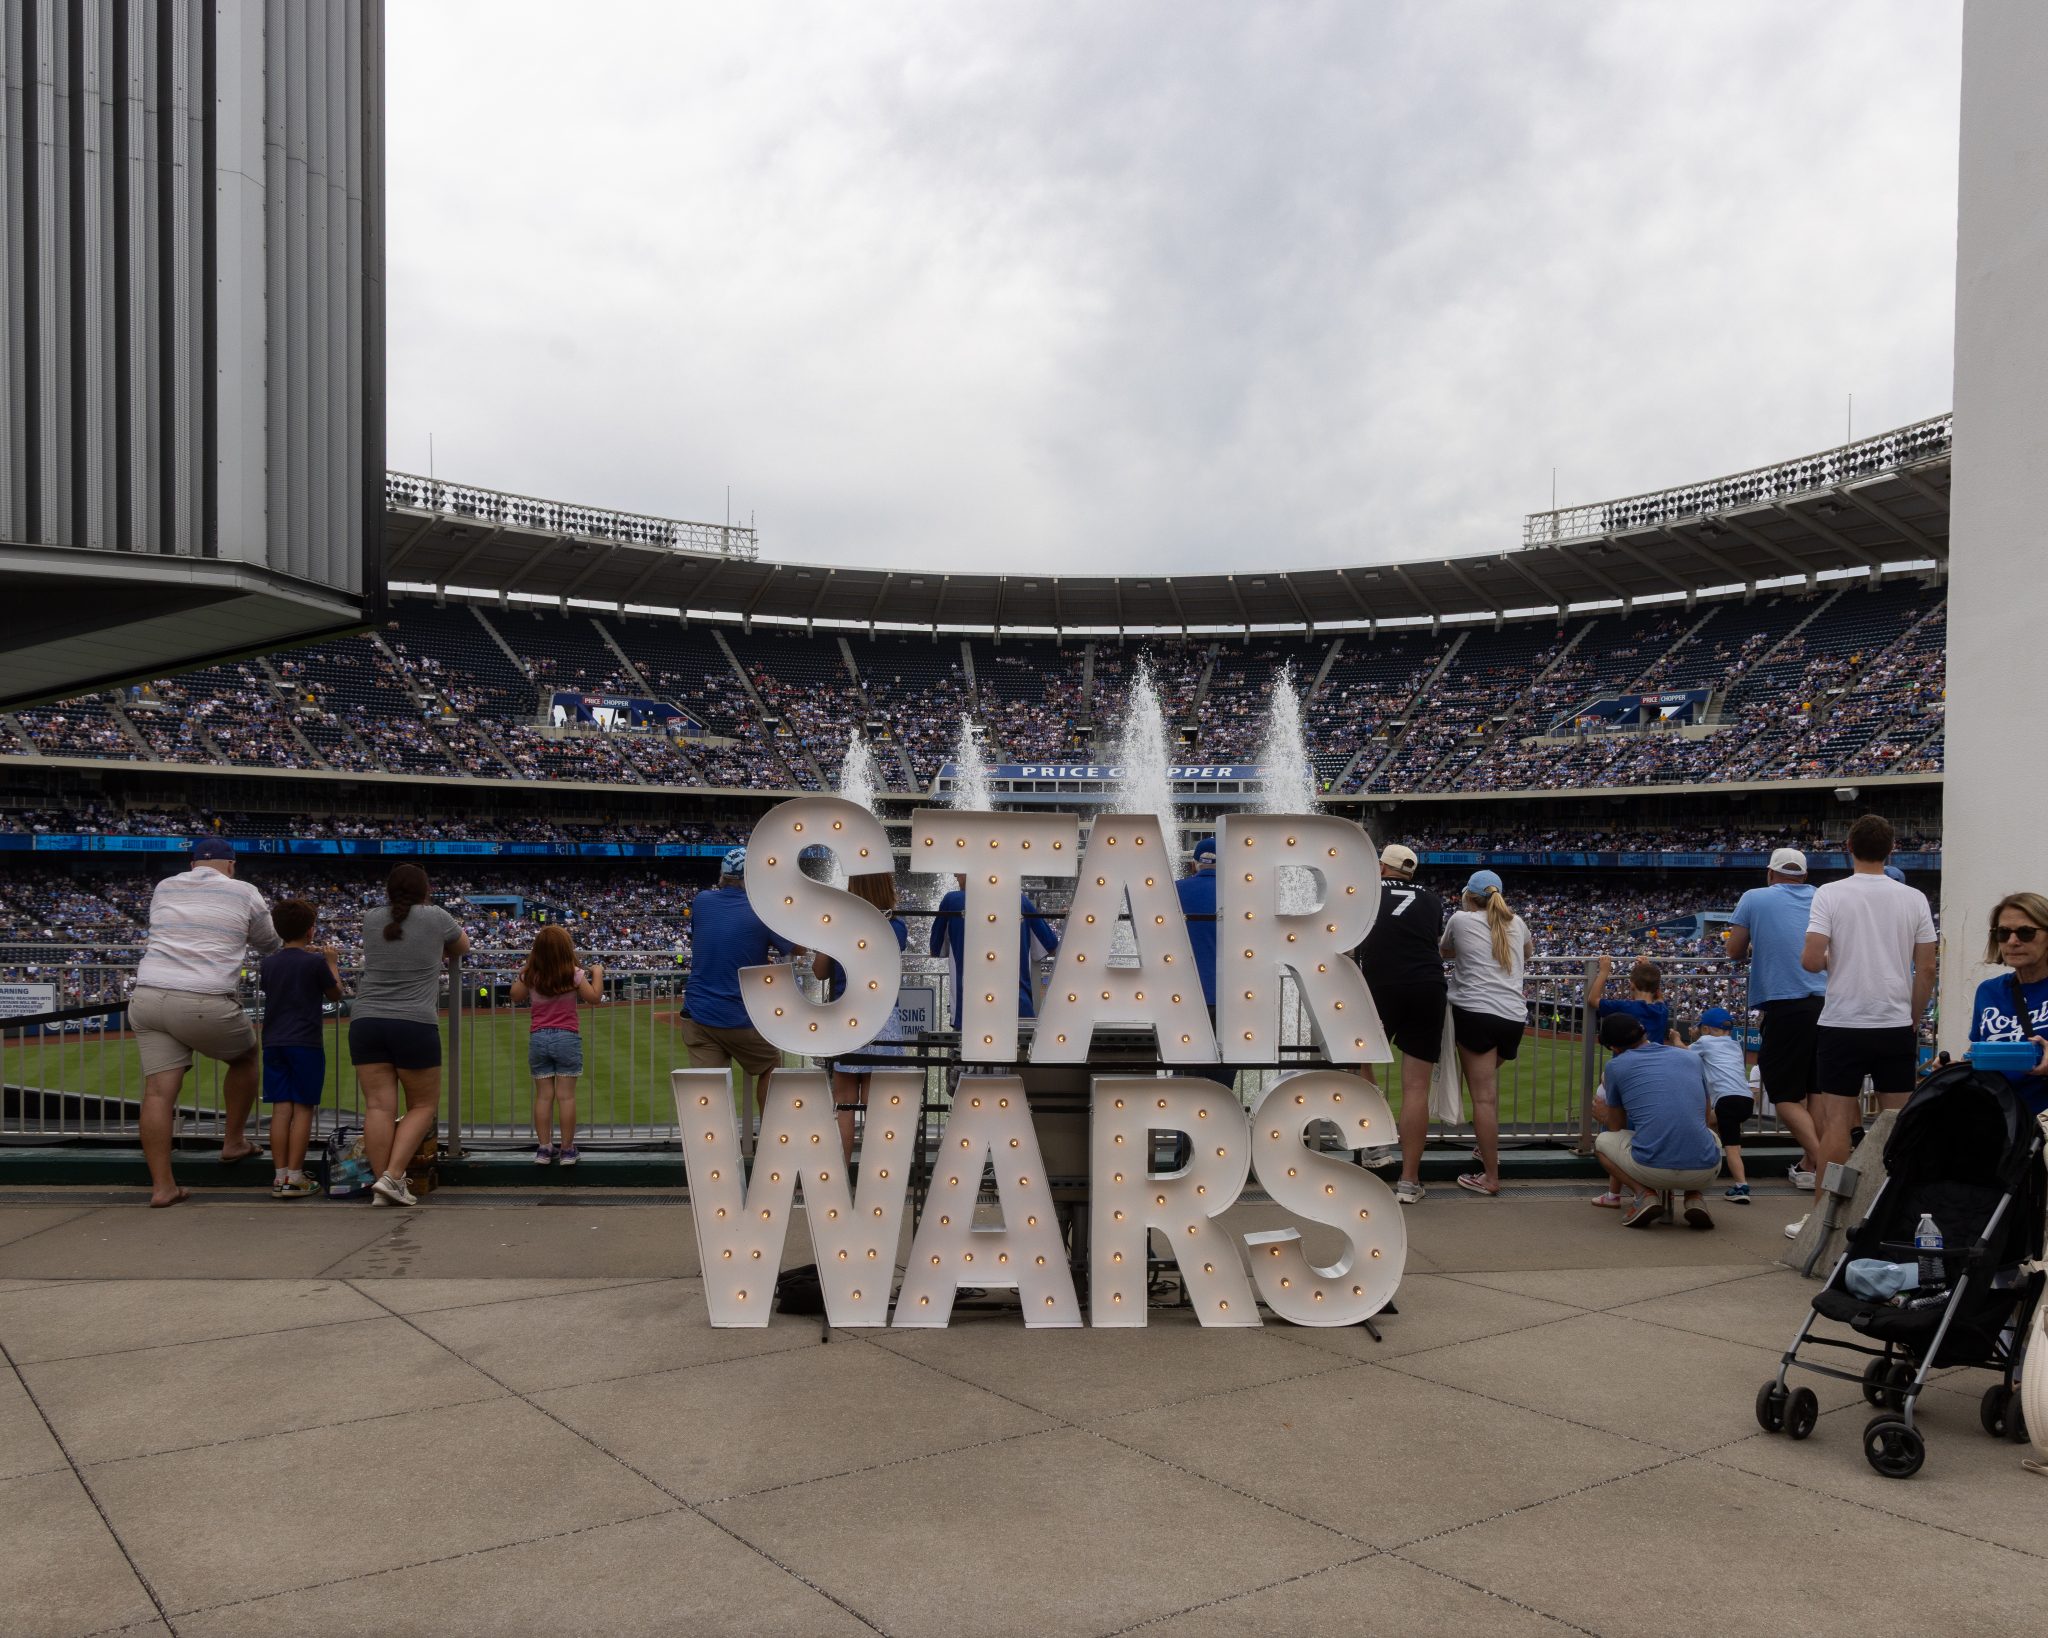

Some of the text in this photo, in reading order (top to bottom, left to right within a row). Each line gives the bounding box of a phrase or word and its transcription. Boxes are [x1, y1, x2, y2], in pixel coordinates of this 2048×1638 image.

[584, 697, 629, 707] PRICE CHOPPER
[1642, 694, 1686, 704] PRICE CHOPPER
[1022, 767, 1232, 777] PRICE CPPER
[1391, 889, 1416, 916] 7
[737, 797, 1393, 1065] STAR
[671, 1067, 1408, 1329] WARS
